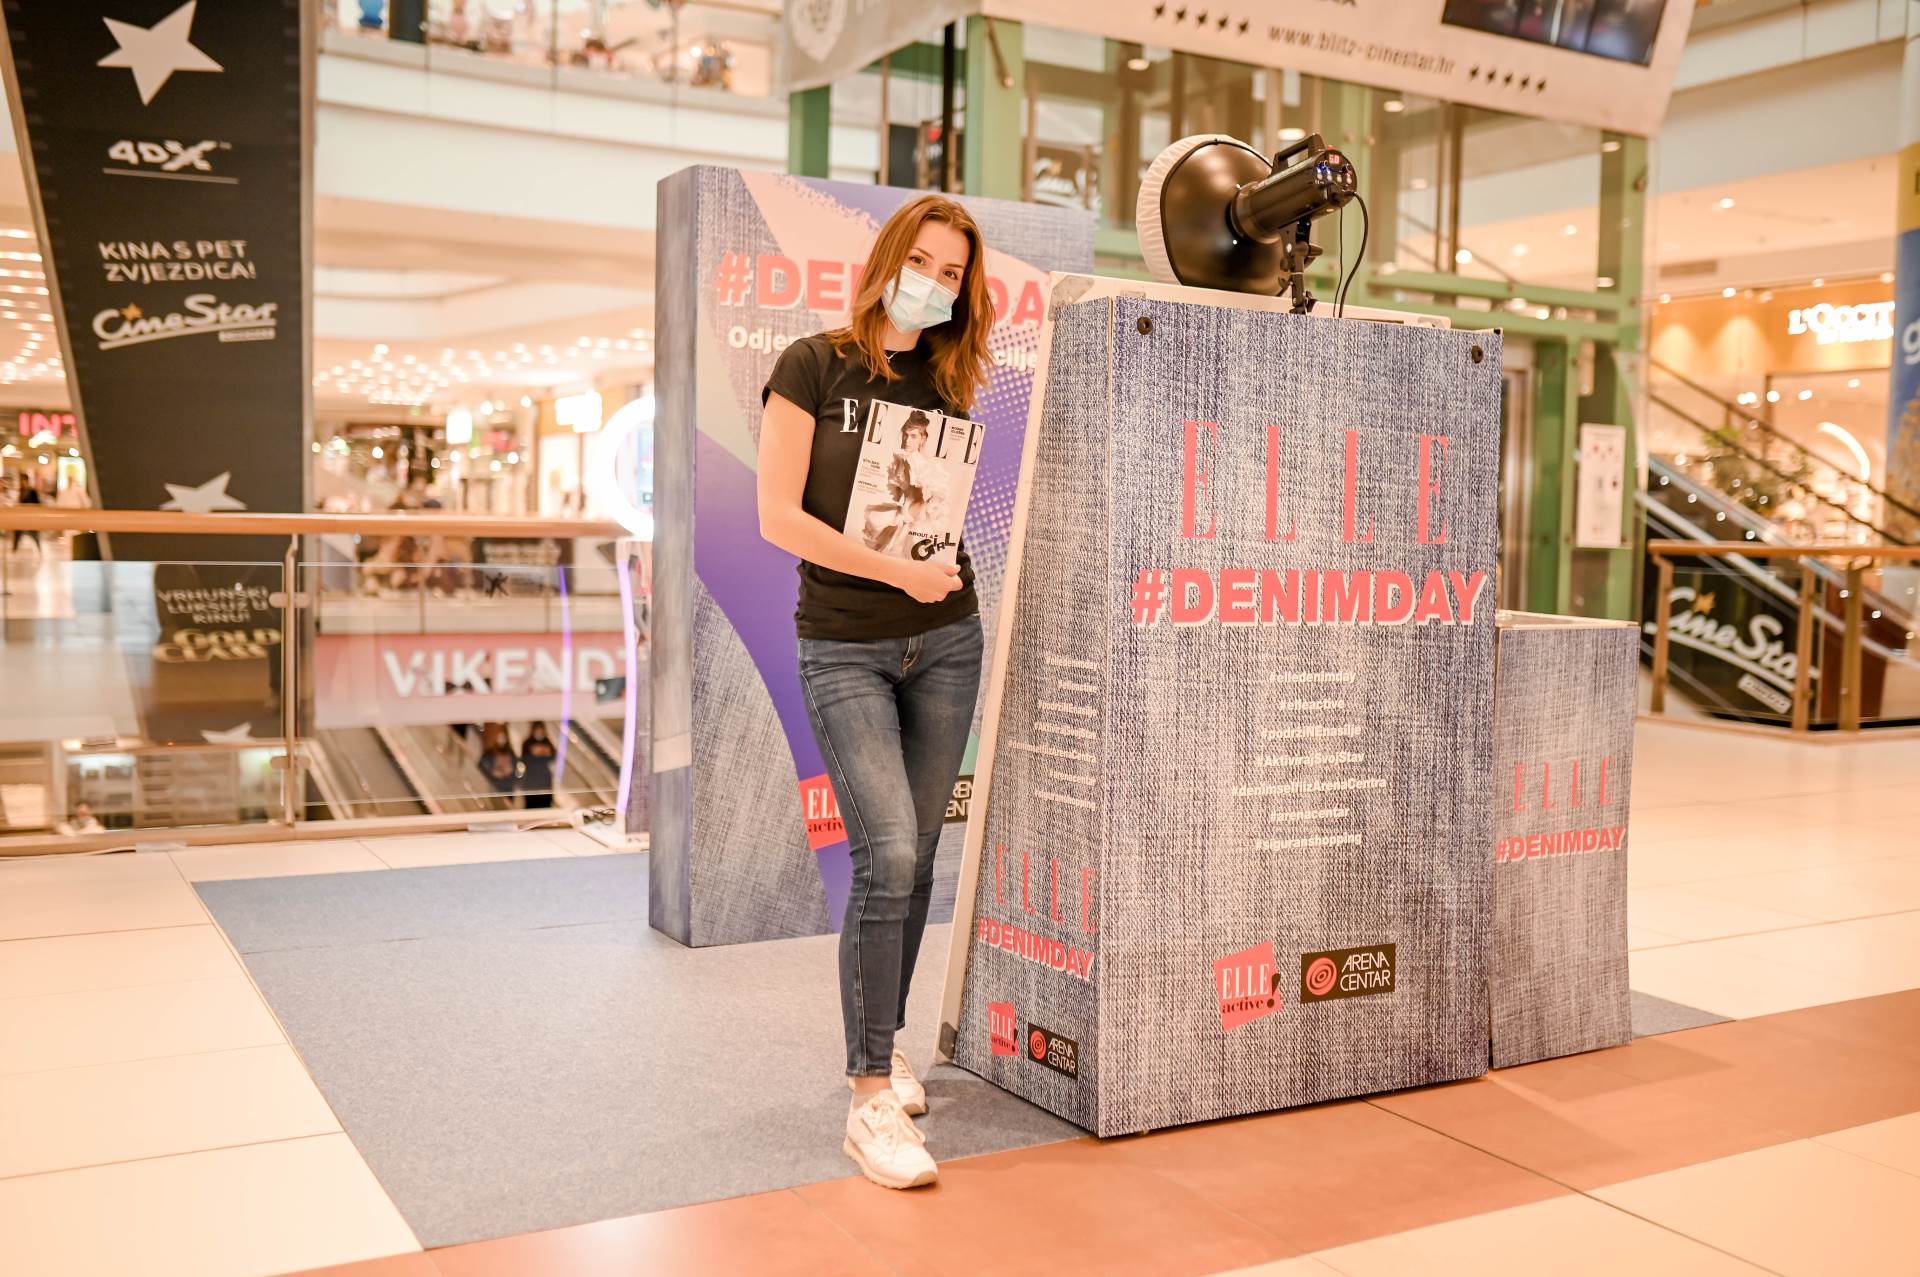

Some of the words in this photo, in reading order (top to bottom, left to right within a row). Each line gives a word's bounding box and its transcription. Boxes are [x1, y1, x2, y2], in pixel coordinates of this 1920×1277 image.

[1267, 25, 1456, 76] www.blitz-cinestar.hr
[108, 139, 217, 171] 4DX
[99, 241, 171, 259] KINA
[173, 240, 193, 259] S
[196, 239, 247, 259] PET
[104, 261, 257, 284] ZVJEZDICA!
[92, 293, 278, 342] CineStar
[867, 401, 984, 465] ELE
[1178, 419, 1450, 546] ELLE
[1129, 567, 1488, 629] #DENIMDAY
[172, 627, 282, 650] GOLD
[1513, 755, 1616, 816] ELLE
[1496, 824, 1627, 863] #DENIMDAY
[995, 842, 1097, 935] ELLE
[977, 915, 1096, 982] #DENIMDAY
[1341, 951, 1391, 973] ARENA
[1222, 962, 1271, 1000] ELLE
[1340, 969, 1391, 992] CENTAR
[991, 1010, 1014, 1042] ELLE
[1047, 1051, 1076, 1075] CENTAR
[1048, 1037, 1076, 1060] ARENA
